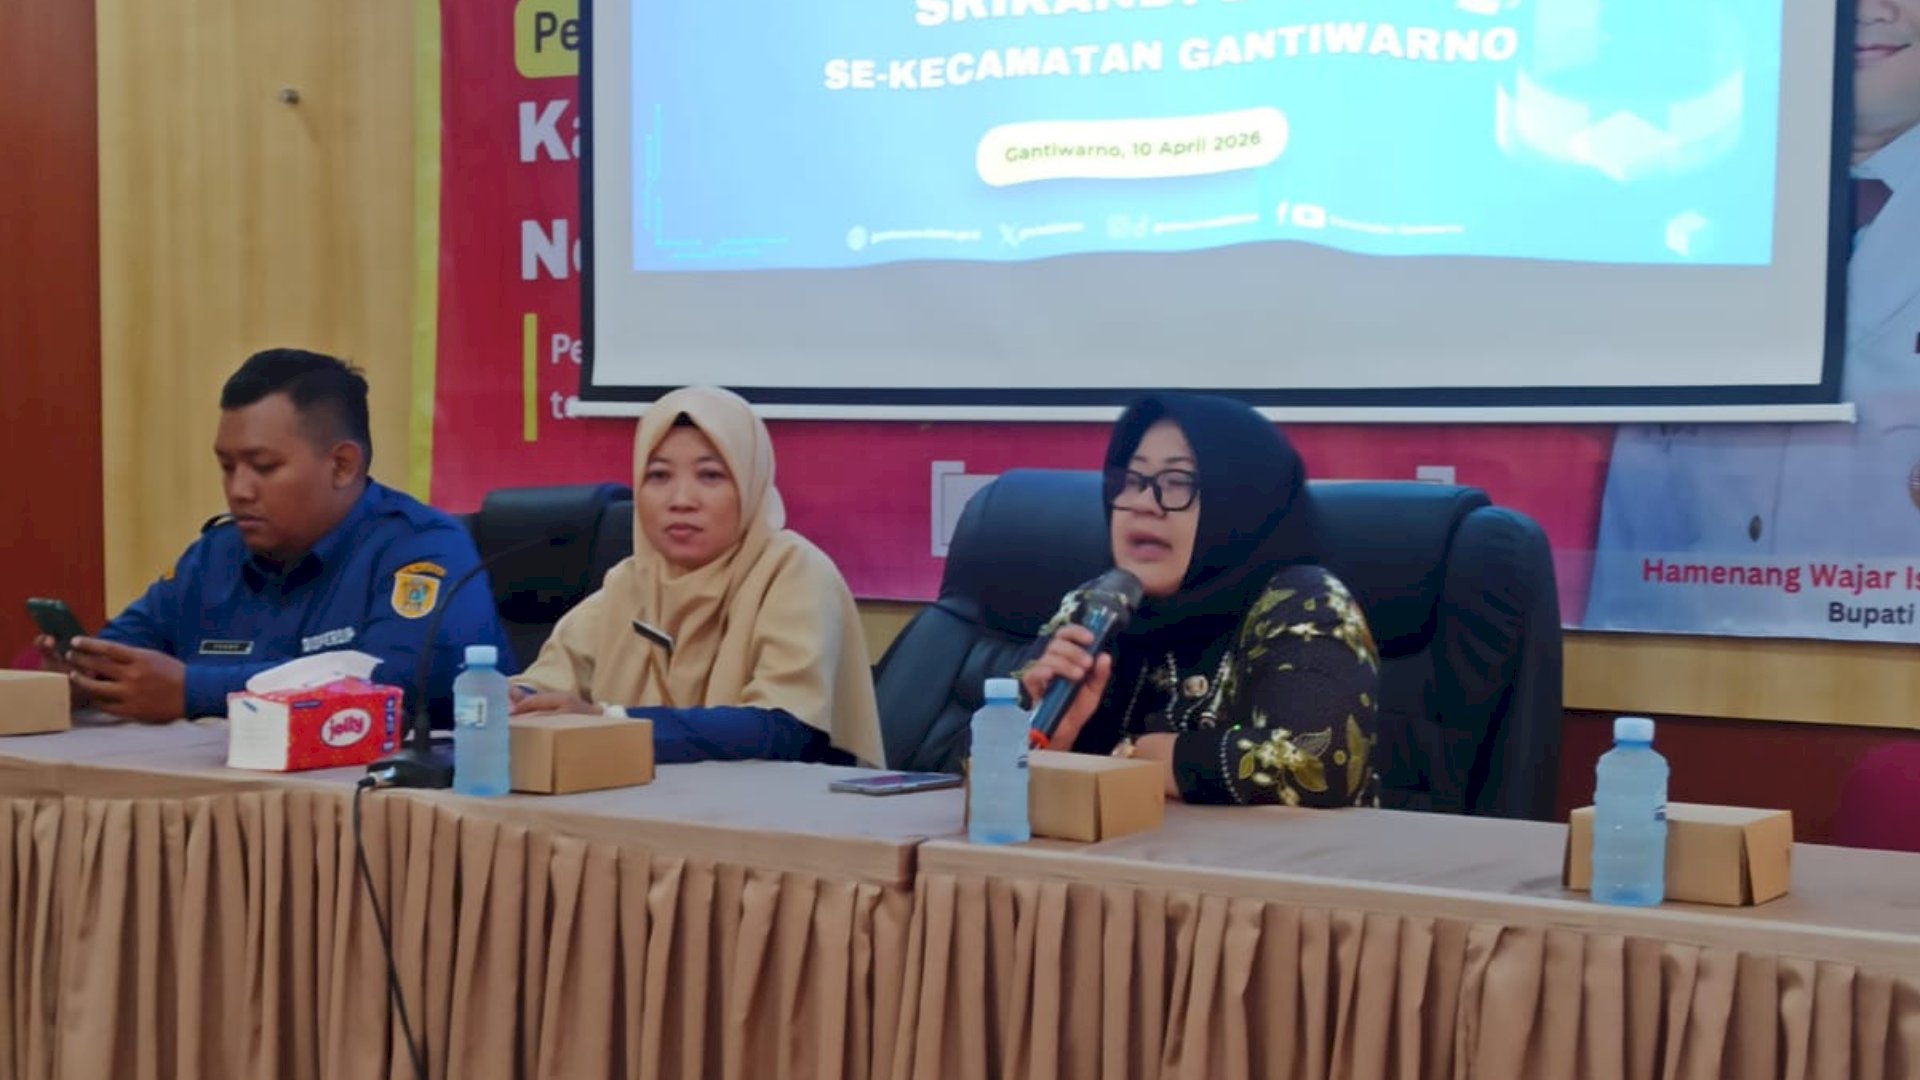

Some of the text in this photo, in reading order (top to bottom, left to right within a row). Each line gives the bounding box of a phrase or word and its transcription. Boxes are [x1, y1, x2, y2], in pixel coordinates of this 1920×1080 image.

[824, 22, 1518, 90] SE-KECAMATAN GANTIWARNO
[1005, 130, 1262, 162] Gantiwarno, 10 April 2026
[1642, 558, 1801, 593] Hamenang
[1809, 563, 1896, 596] Wajar
[1828, 602, 1914, 629] Bupati
[328, 715, 365, 742] jolly
